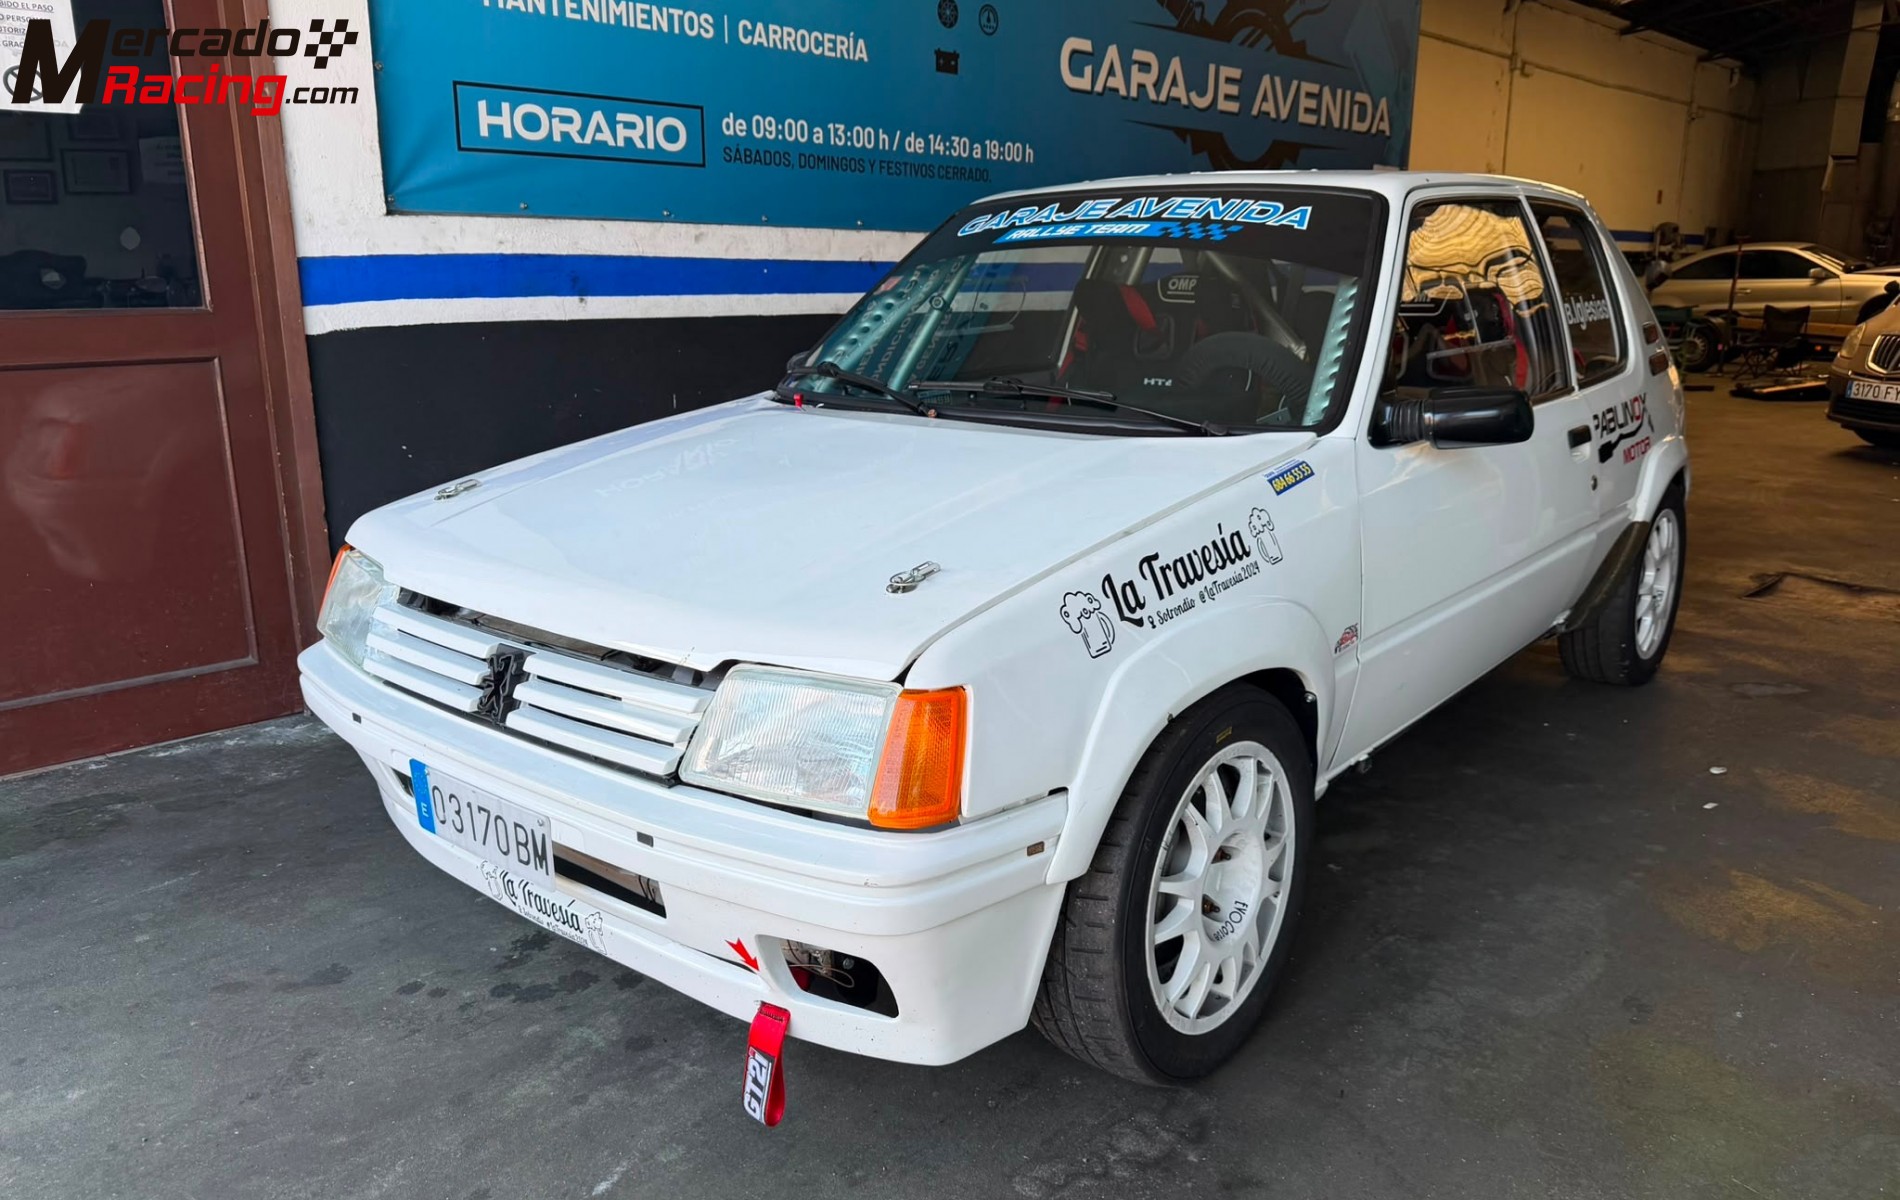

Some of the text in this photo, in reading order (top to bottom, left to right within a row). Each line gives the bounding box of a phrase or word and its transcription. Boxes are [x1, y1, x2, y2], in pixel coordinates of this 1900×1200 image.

[32, 3, 54, 12] PASO
[482, 0, 869, 62] NTENIMIENTOS CARROCERÍA
[1060, 36, 1392, 137] GARAJE AVENIDA
[477, 99, 687, 152] HORARIO
[722, 112, 747, 137] de
[752, 115, 808, 143] 09:00
[813, 126, 823, 144] a
[828, 122, 875, 149] 13:00
[879, 128, 889, 150] h
[905, 131, 925, 154] de
[929, 134, 969, 158] 14:30
[973, 143, 982, 159] a
[985, 140, 1022, 162] 19:00
[1026, 143, 1034, 163] h
[723, 144, 992, 183] SÁBADOS, DOMINGOS Y FESTIVOS CERRADO.
[957, 197, 1313, 237] GARAJE AVENIDA
[1005, 224, 1149, 240] RALLYE TEAM
[1168, 279, 1197, 291] OMP
[1852, 382, 1881, 399] 3170
[1592, 392, 1651, 438] PABLINOX
[1101, 522, 1251, 628] La Travesía
[420, 802, 429, 818] E
[500, 869, 518, 907] La
[517, 879, 584, 934] Travesía
